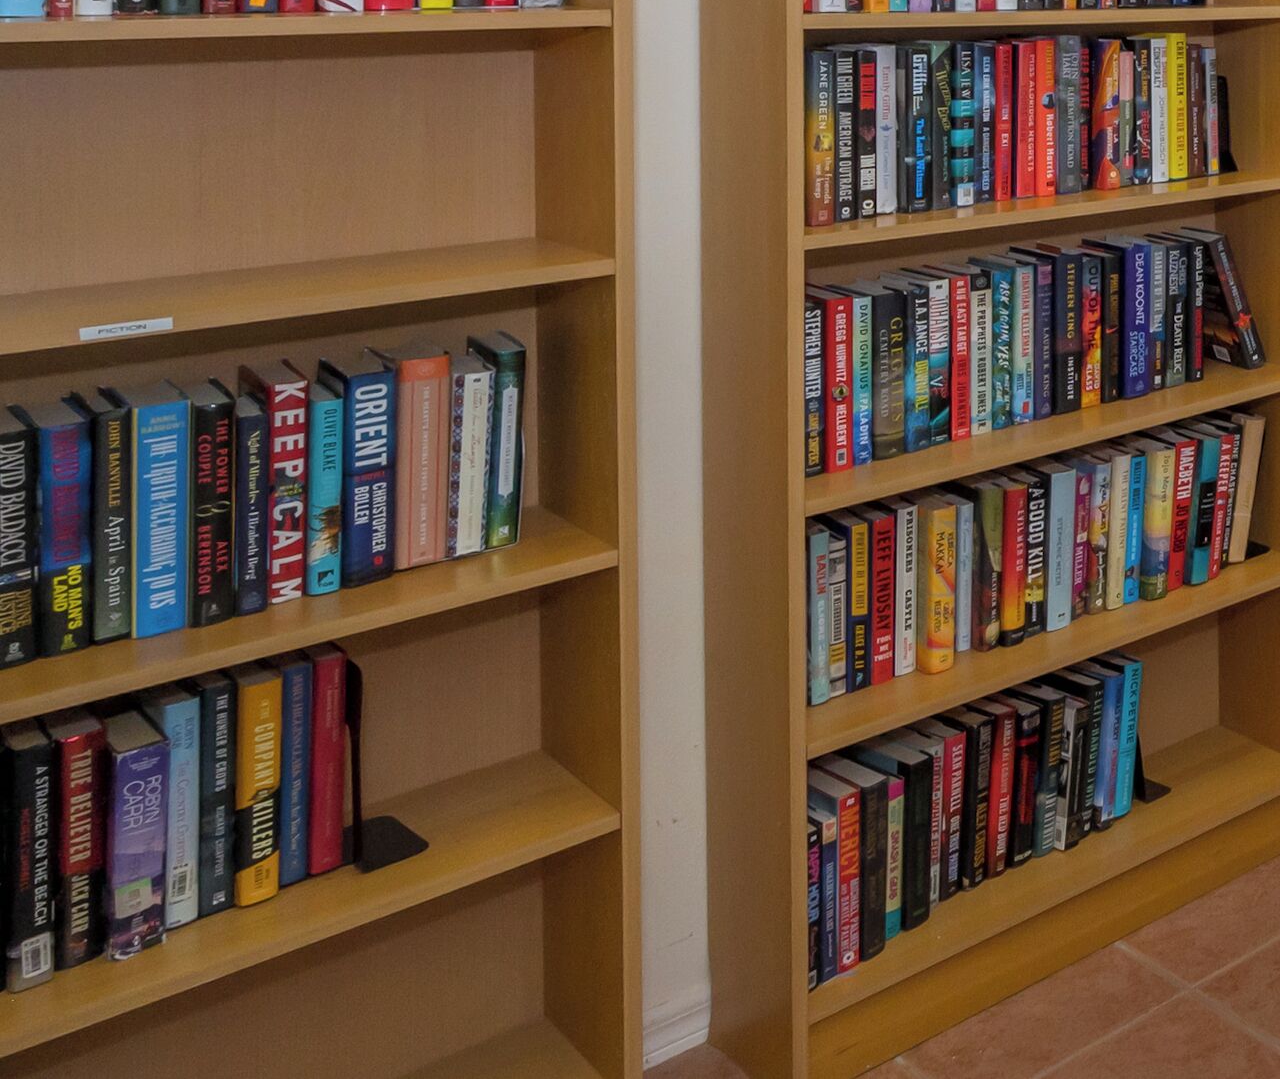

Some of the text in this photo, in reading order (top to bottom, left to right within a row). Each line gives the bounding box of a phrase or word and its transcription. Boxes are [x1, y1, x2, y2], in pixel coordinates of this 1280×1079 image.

[819, 60, 827, 129] JANE GREEN
[837, 57, 853, 104] TIM GREEN
[913, 54, 927, 95] Griffin
[961, 51, 971, 116] LISA JEWELL
[840, 112, 853, 201] AMERICAN OUTRAGE
[1135, 253, 1145, 325] DEAN KOONTZ
[98, 324, 147, 335] FICTION
[805, 310, 821, 399] STEPHEN HUNTER
[836, 314, 846, 381] GREGG HURWITZ
[860, 305, 868, 390] DAVID IGNATIUS
[890, 317, 903, 371] GREG
[915, 316, 927, 353] JANCE
[1174, 315, 1183, 372] DEATH RELIC
[215, 418, 228, 494] THE POWER
[275, 381, 307, 478] KEEP
[323, 408, 337, 471] OLIVIE BLAKE
[355, 383, 387, 467] ORIENT
[107, 421, 120, 507] JOHN BANVILLE
[198, 435, 211, 484] COUPLE
[1177, 446, 1194, 499] MACBETH
[0, 440, 25, 566] DAVID BALDACCI
[354, 486, 368, 525] BOLLEN
[372, 483, 386, 553] CHRISTOPHER
[1028, 488, 1045, 583] A GOOD KILL
[198, 526, 211, 595] BERENSON
[216, 541, 228, 572] ALEX
[272, 501, 305, 604] CALM
[877, 530, 891, 629] JEFF LINDSAY
[1075, 546, 1083, 585] MILLER
[52, 575, 67, 612] LAND
[68, 564, 82, 630] NO MAN'S
[1125, 666, 1139, 745] NICK PETRIE
[255, 723, 274, 788] COMPANY
[35, 776, 48, 837] STRANGER
[70, 750, 92, 863] TRUE BELIEVER
[123, 782, 144, 830] CARR
[142, 775, 161, 828] ROBYN
[252, 802, 273, 861] KILLERS
[34, 861, 47, 882] THE
[35, 839, 47, 858] ON
[840, 808, 858, 876] MERCY
[34, 885, 47, 927] BEACH
